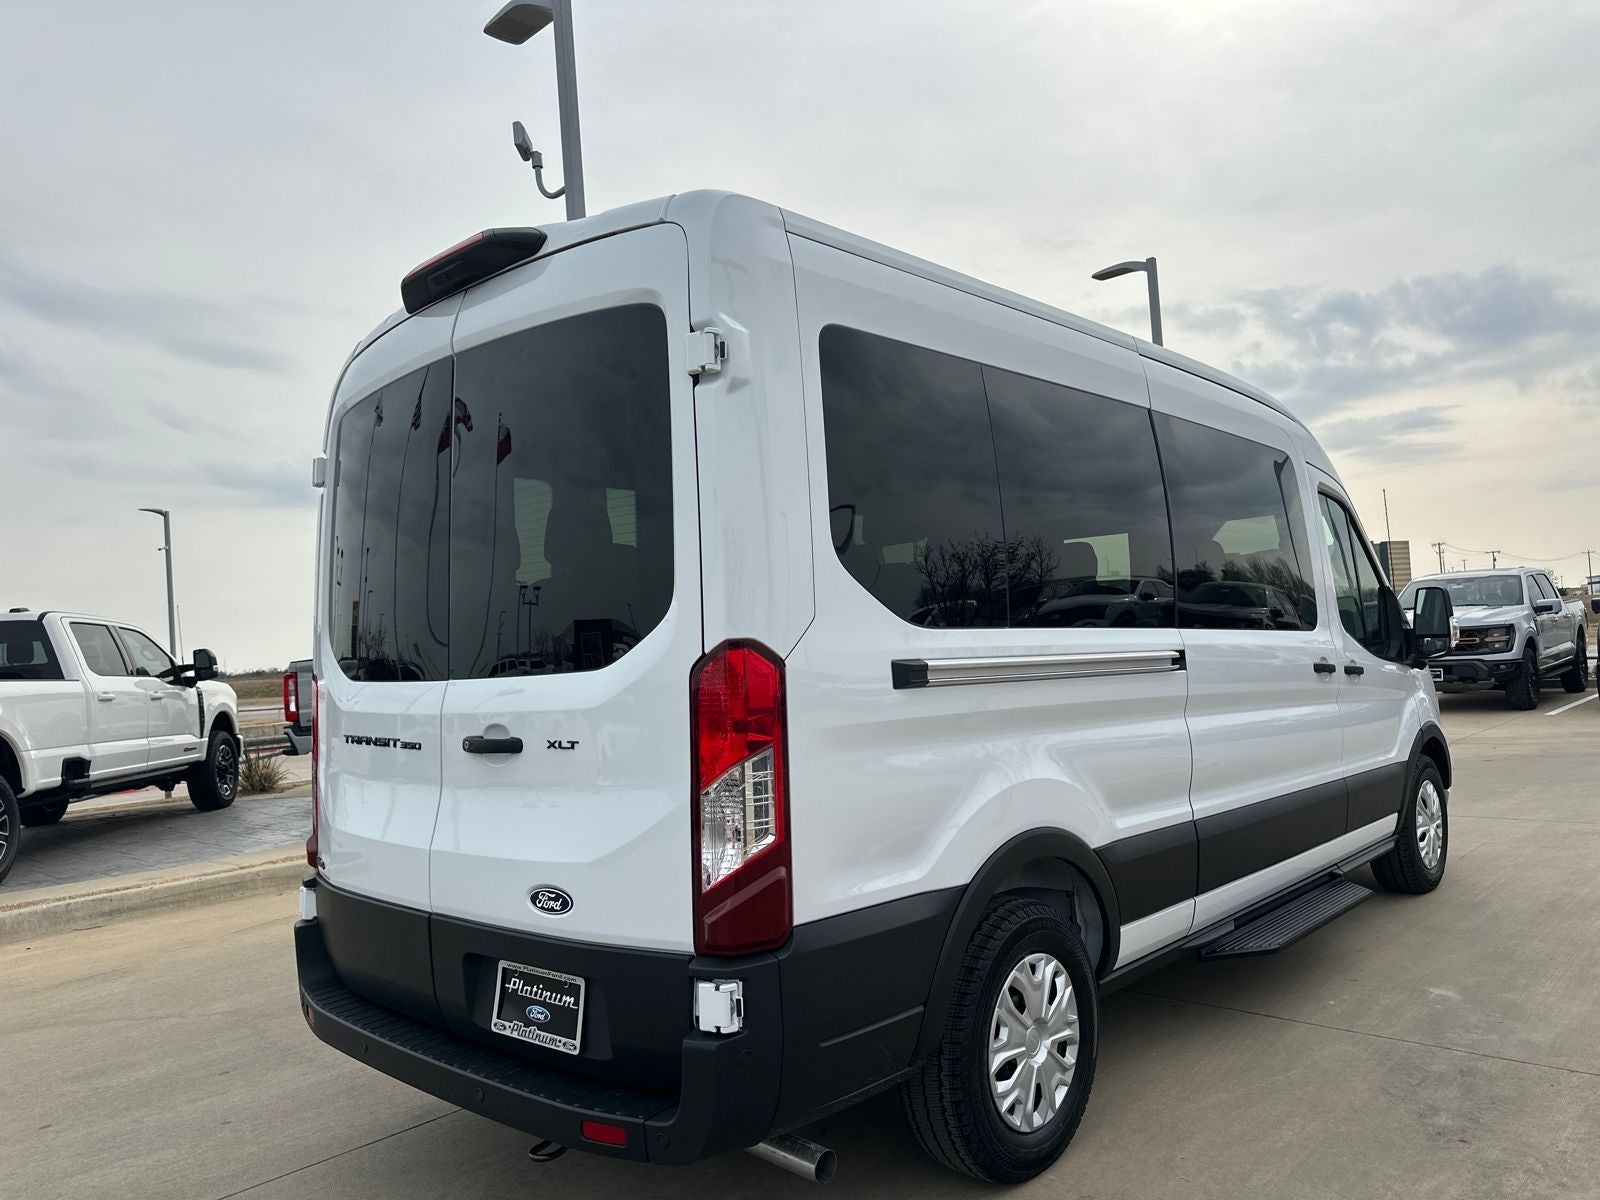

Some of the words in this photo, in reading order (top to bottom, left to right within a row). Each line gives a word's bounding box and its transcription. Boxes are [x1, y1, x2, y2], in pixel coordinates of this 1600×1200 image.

[343, 734, 400, 749] TRANSIT
[399, 741, 422, 750] 350
[546, 739, 579, 750] XLT
[536, 891, 562, 910] Ford
[507, 963, 577, 983] www.PlatinumFord.com
[505, 977, 579, 1009] Platinum
[510, 1021, 561, 1047] Platinum
